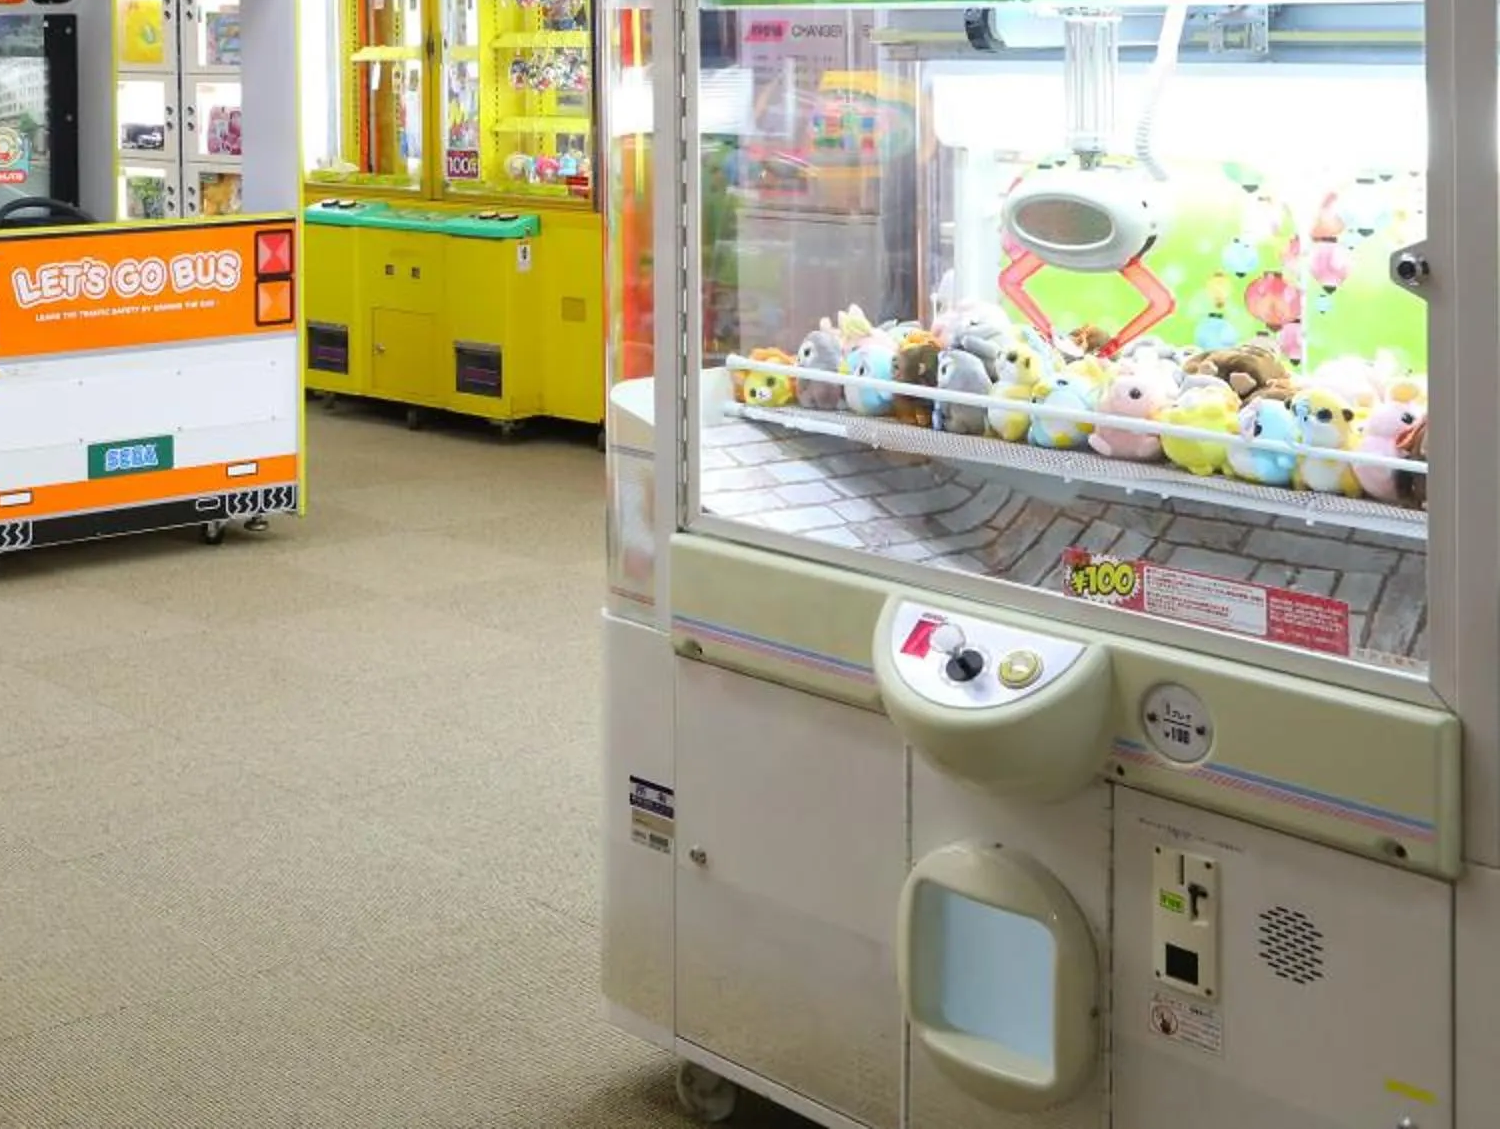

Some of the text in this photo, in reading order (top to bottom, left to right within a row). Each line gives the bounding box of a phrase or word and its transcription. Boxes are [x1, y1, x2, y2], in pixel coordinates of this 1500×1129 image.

[13, 250, 242, 308] LET'S GO BUS
[105, 443, 159, 471] SEGA
[1070, 561, 1134, 596] ¥100
